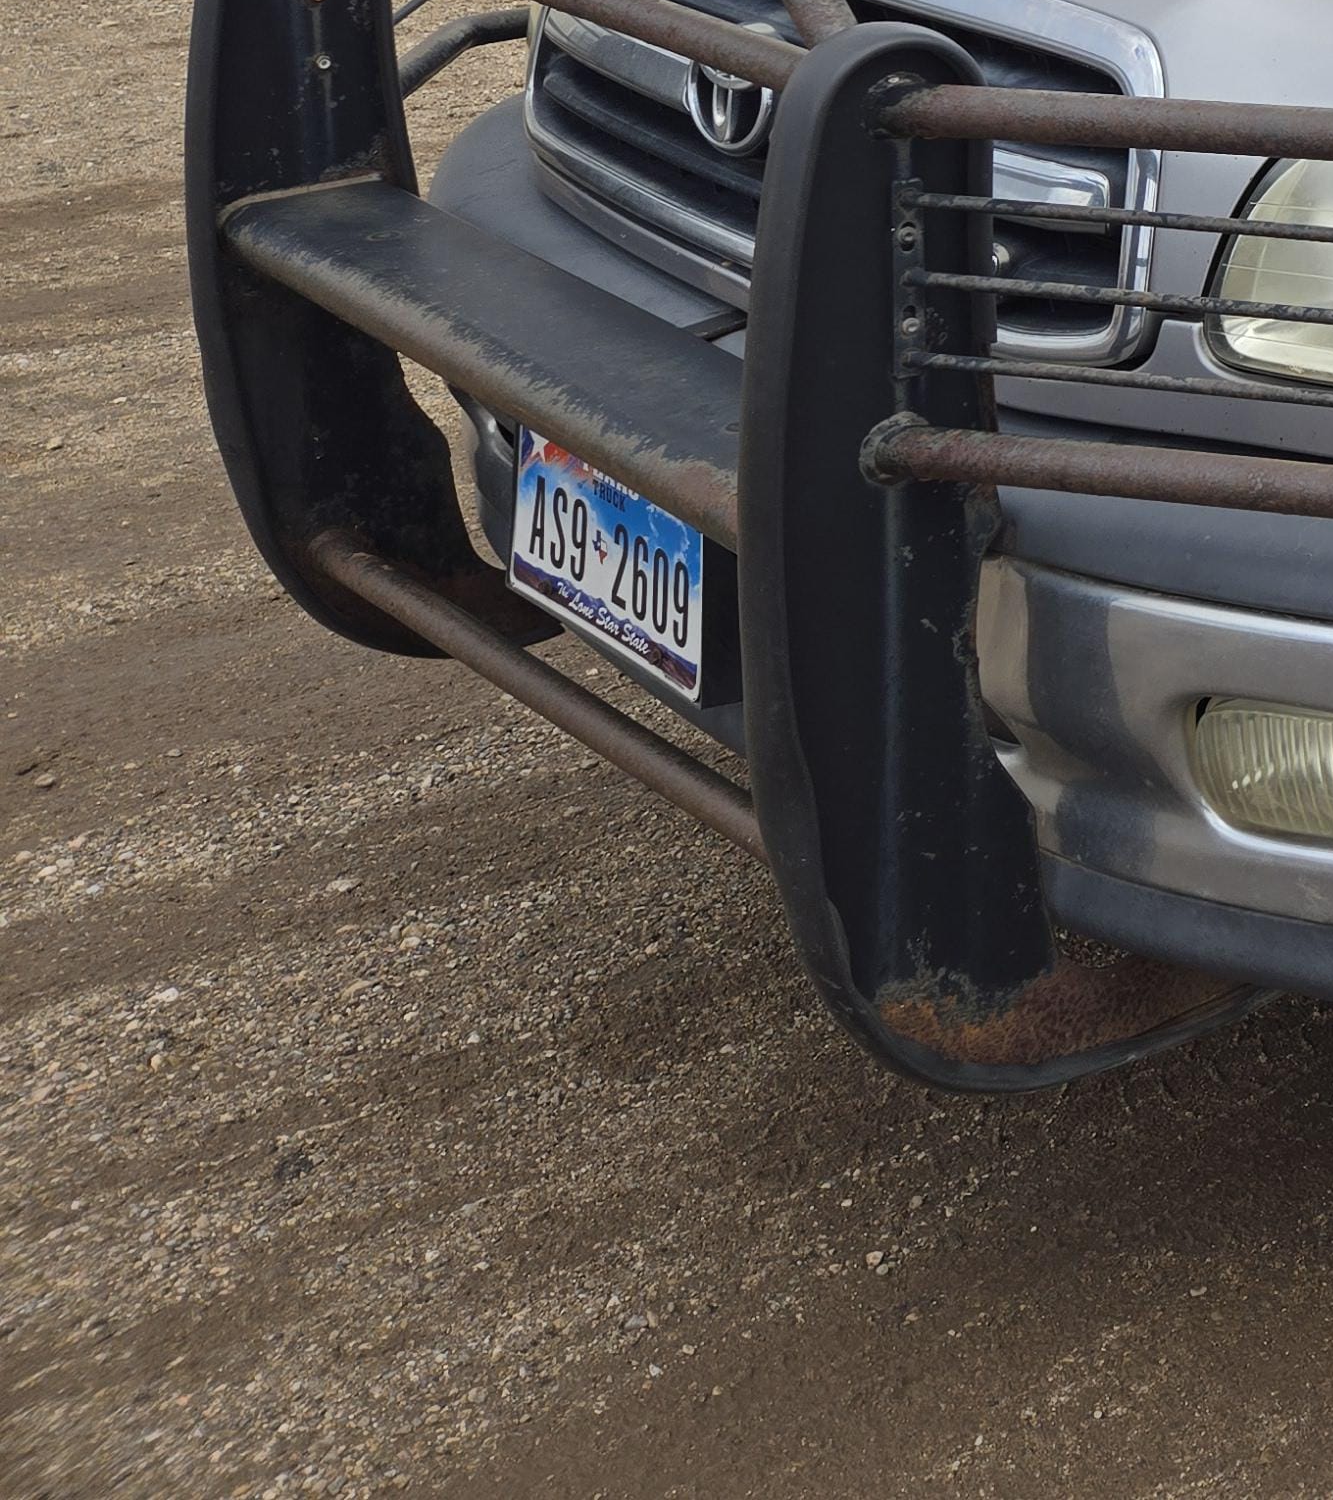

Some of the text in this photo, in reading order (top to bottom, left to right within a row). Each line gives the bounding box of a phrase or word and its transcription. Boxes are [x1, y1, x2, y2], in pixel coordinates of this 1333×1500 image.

[592, 477, 627, 512] TRUCK
[529, 474, 690, 649] AS9 2609
[568, 590, 595, 622] Lone
[595, 607, 620, 638] Star
[619, 623, 650, 657] State
